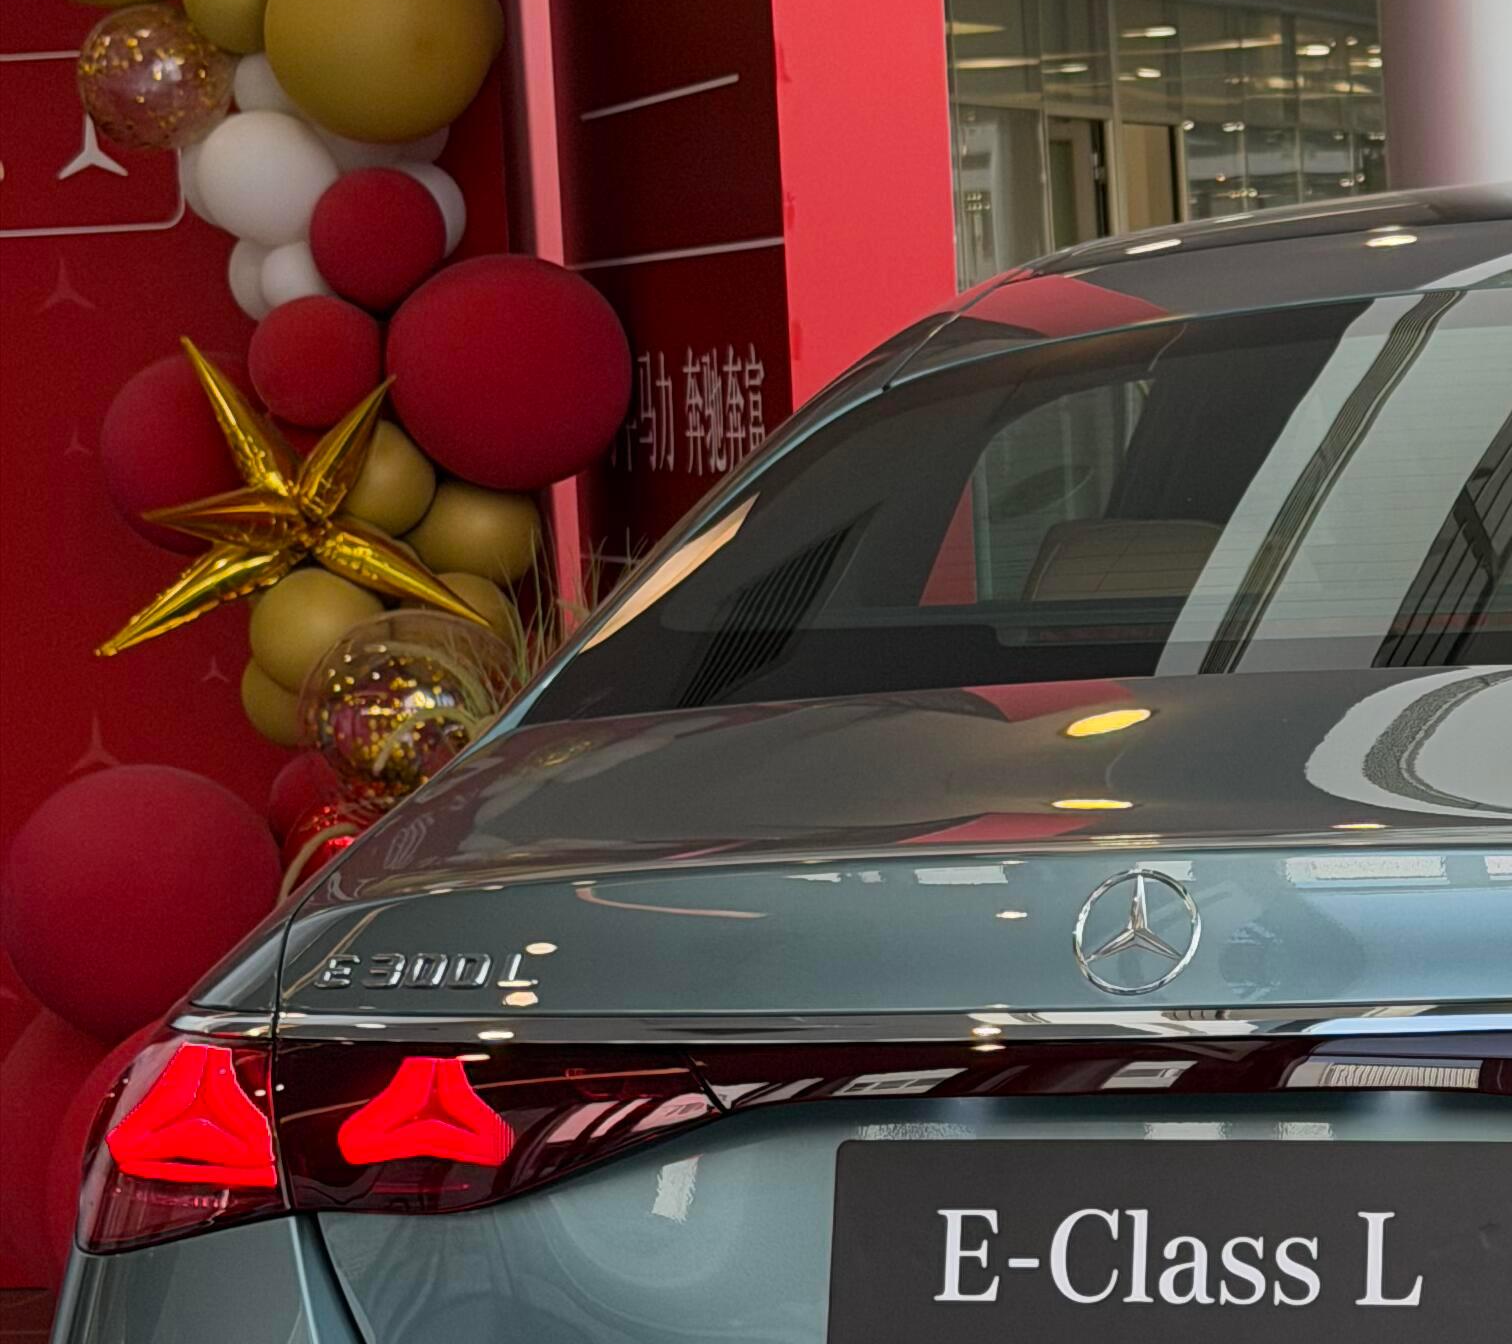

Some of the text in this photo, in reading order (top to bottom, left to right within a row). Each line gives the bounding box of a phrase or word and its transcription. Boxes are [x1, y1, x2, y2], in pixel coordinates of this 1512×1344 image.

[496, 953, 539, 988] L
[933, 1207, 1424, 1307] E-Class L
